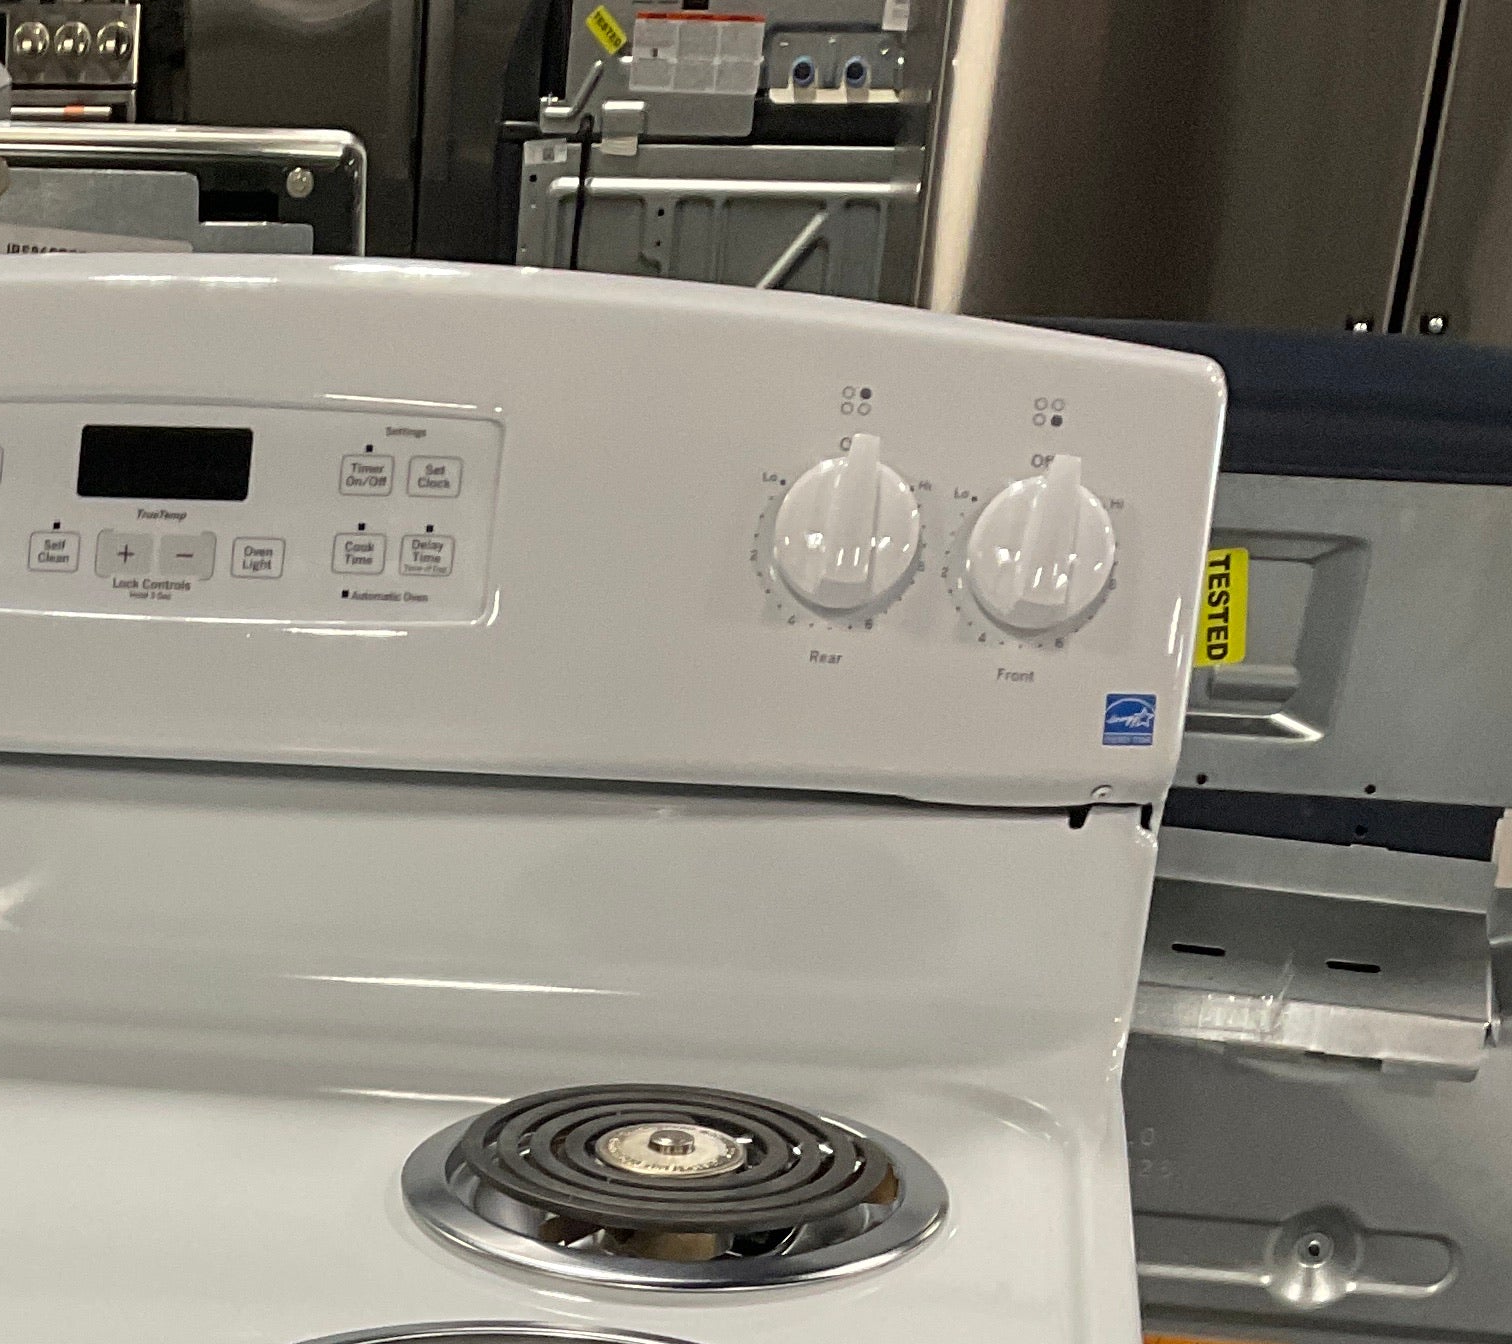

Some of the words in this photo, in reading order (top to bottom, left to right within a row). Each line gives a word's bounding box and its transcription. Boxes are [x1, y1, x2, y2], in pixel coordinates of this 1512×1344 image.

[385, 426, 427, 438] Settings
[1030, 453, 1056, 468] Of
[351, 462, 385, 474] Timer
[425, 463, 446, 476] Set
[345, 475, 388, 488] On/Off
[417, 476, 451, 489] Clock
[762, 471, 778, 483] Lo
[953, 486, 970, 499] Lo
[136, 508, 188, 523] TrueTemp
[43, 538, 67, 551] Self
[344, 540, 375, 553] Cook
[411, 539, 444, 553] Delay
[37, 551, 70, 564] Clean
[243, 545, 273, 558] Oven
[412, 551, 441, 563] Time
[242, 559, 272, 573] Light
[345, 554, 373, 566] Time
[112, 577, 139, 590] Lock
[142, 577, 192, 591] Controls
[351, 590, 401, 602] Automatic
[403, 592, 429, 603] Oven
[1205, 553, 1231, 661] TESTED
[809, 650, 844, 664] Rear
[995, 667, 1035, 683] Front
